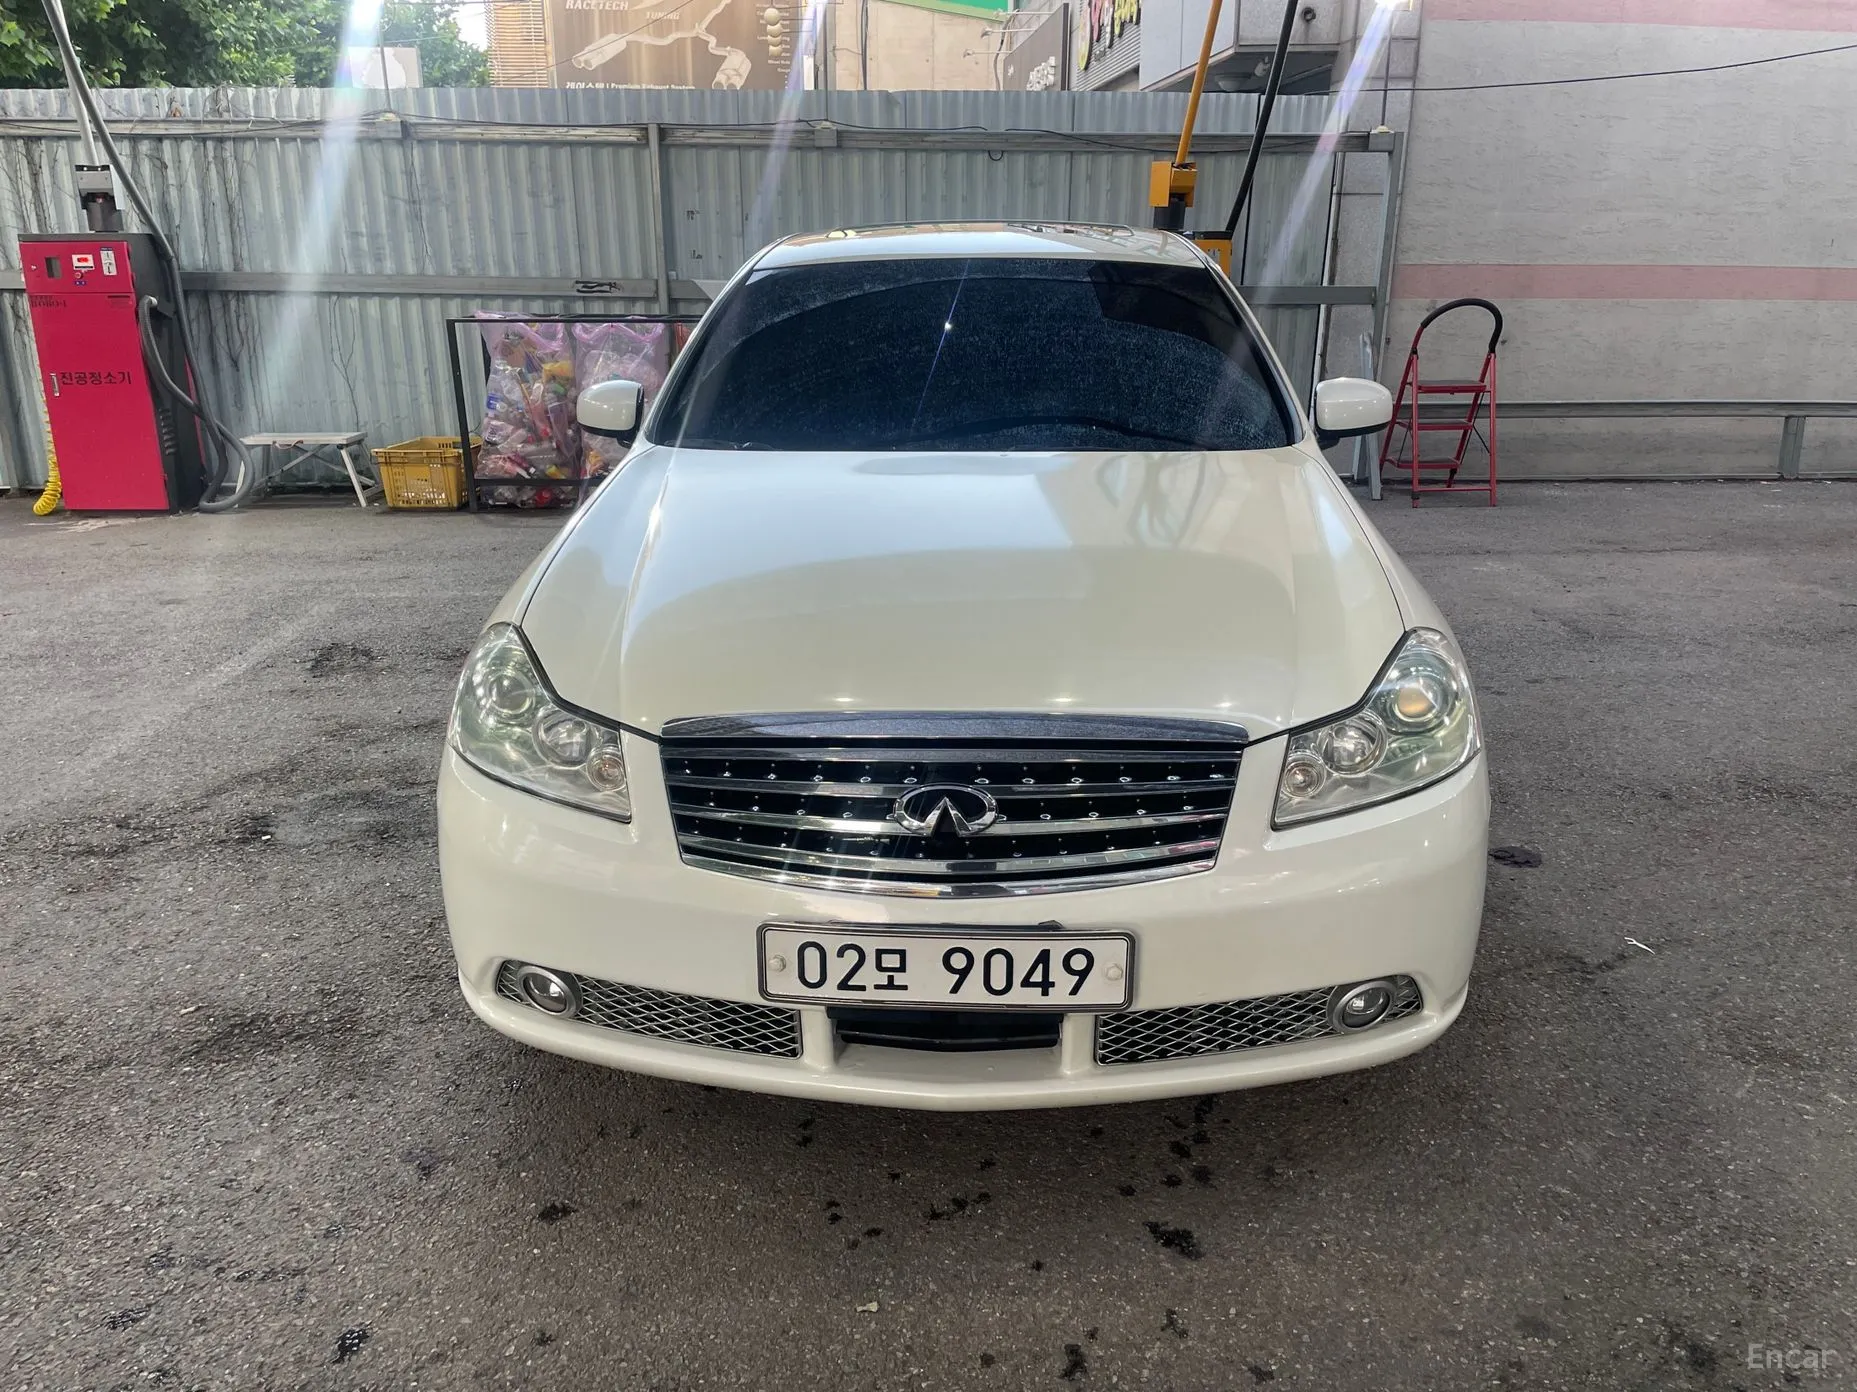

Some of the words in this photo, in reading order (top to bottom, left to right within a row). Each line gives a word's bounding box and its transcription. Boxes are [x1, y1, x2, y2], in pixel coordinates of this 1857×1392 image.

[565, 0, 629, 10] RACETECH
[60, 371, 132, 385] 진공청소기
[797, 940, 908, 991] 02모
[941, 946, 1095, 997] 9049
